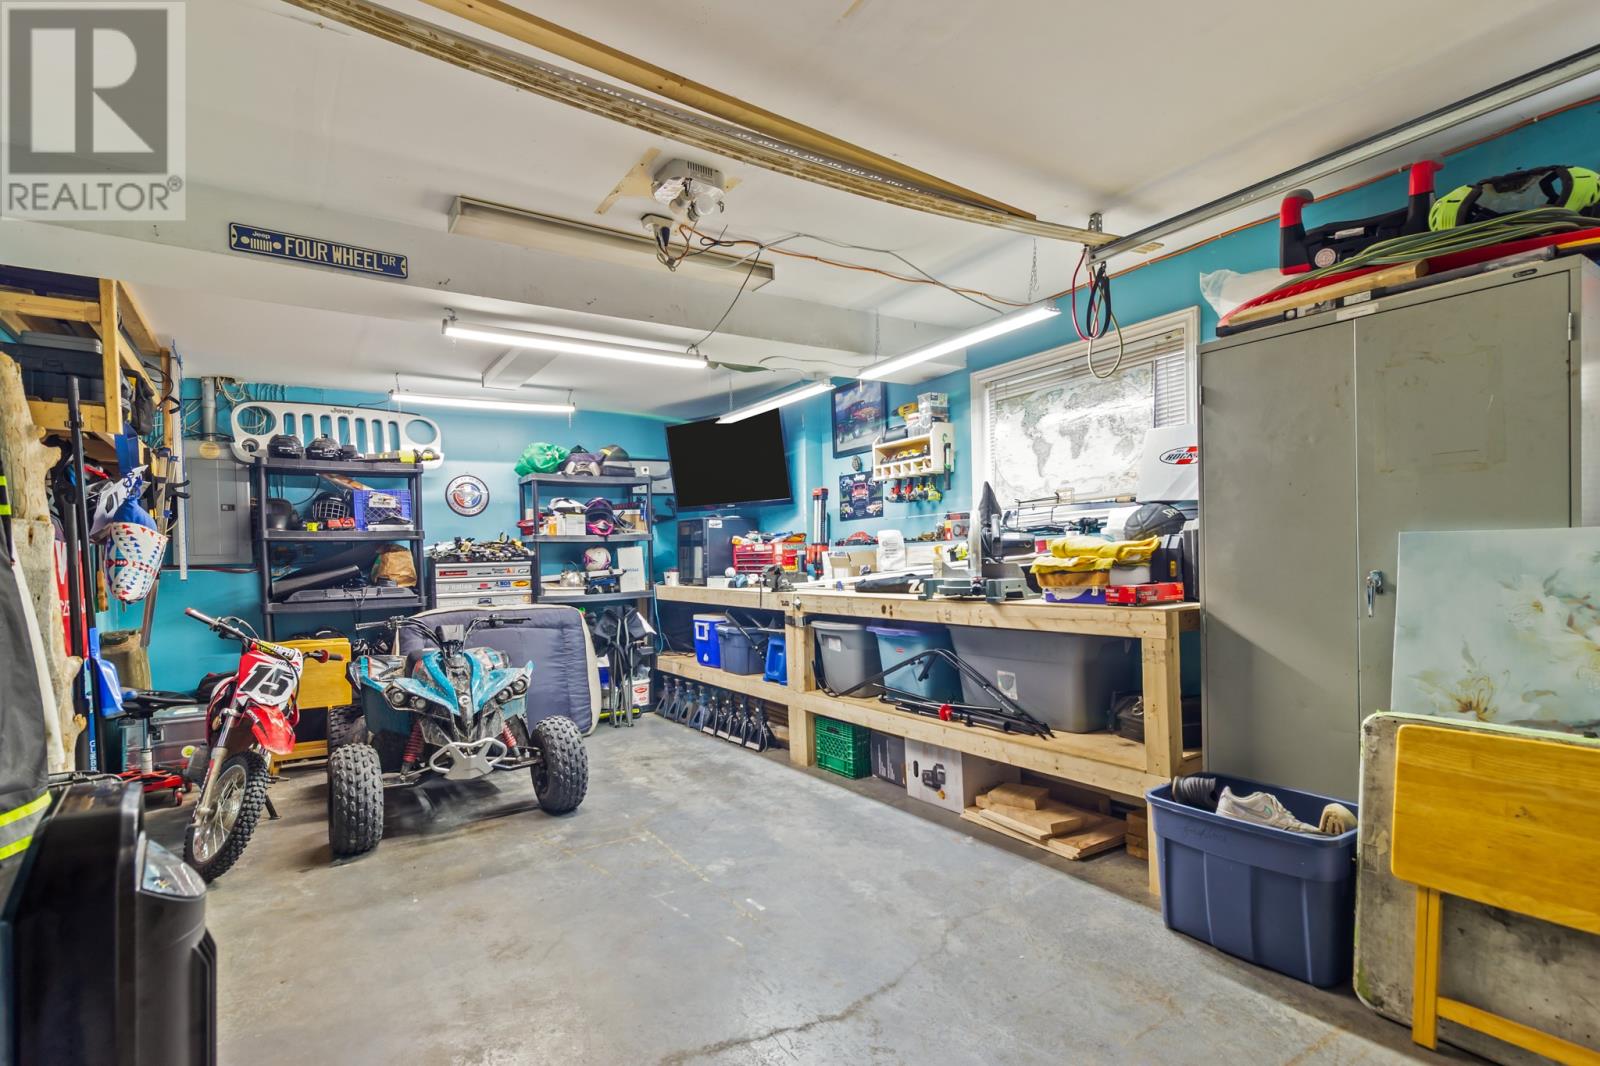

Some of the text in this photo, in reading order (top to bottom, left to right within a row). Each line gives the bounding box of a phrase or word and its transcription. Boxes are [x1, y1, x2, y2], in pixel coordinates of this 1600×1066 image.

[252, 231, 271, 239] Jeep
[284, 236, 396, 271] FOUR WHEEL DR
[240, 664, 294, 697] 15
